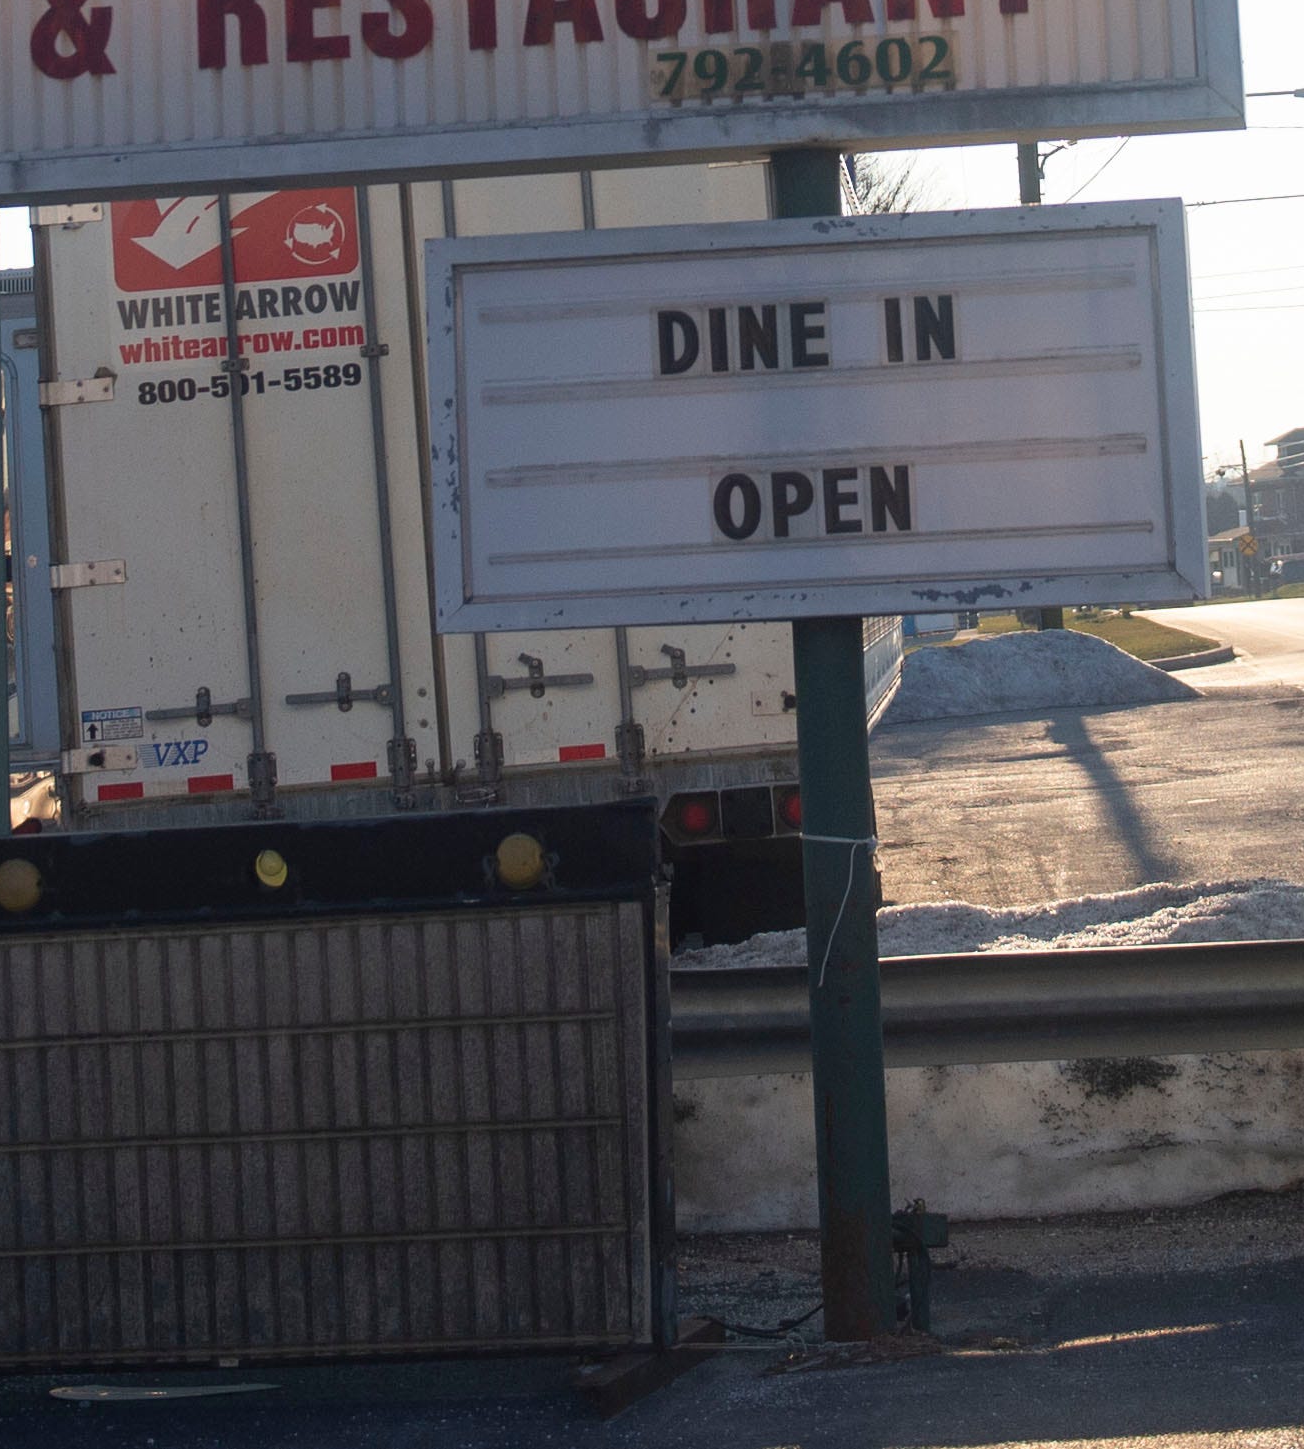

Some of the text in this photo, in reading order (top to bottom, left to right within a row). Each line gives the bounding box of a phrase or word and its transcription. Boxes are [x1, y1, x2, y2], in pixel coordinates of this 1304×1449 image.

[656, 35, 954, 98] 792-4602
[117, 280, 361, 331] WHITE ARROW
[119, 324, 365, 365] whitearrow.com
[656, 294, 956, 375] DINE IN
[713, 464, 913, 541] OPEN
[153, 739, 208, 767] VXP
